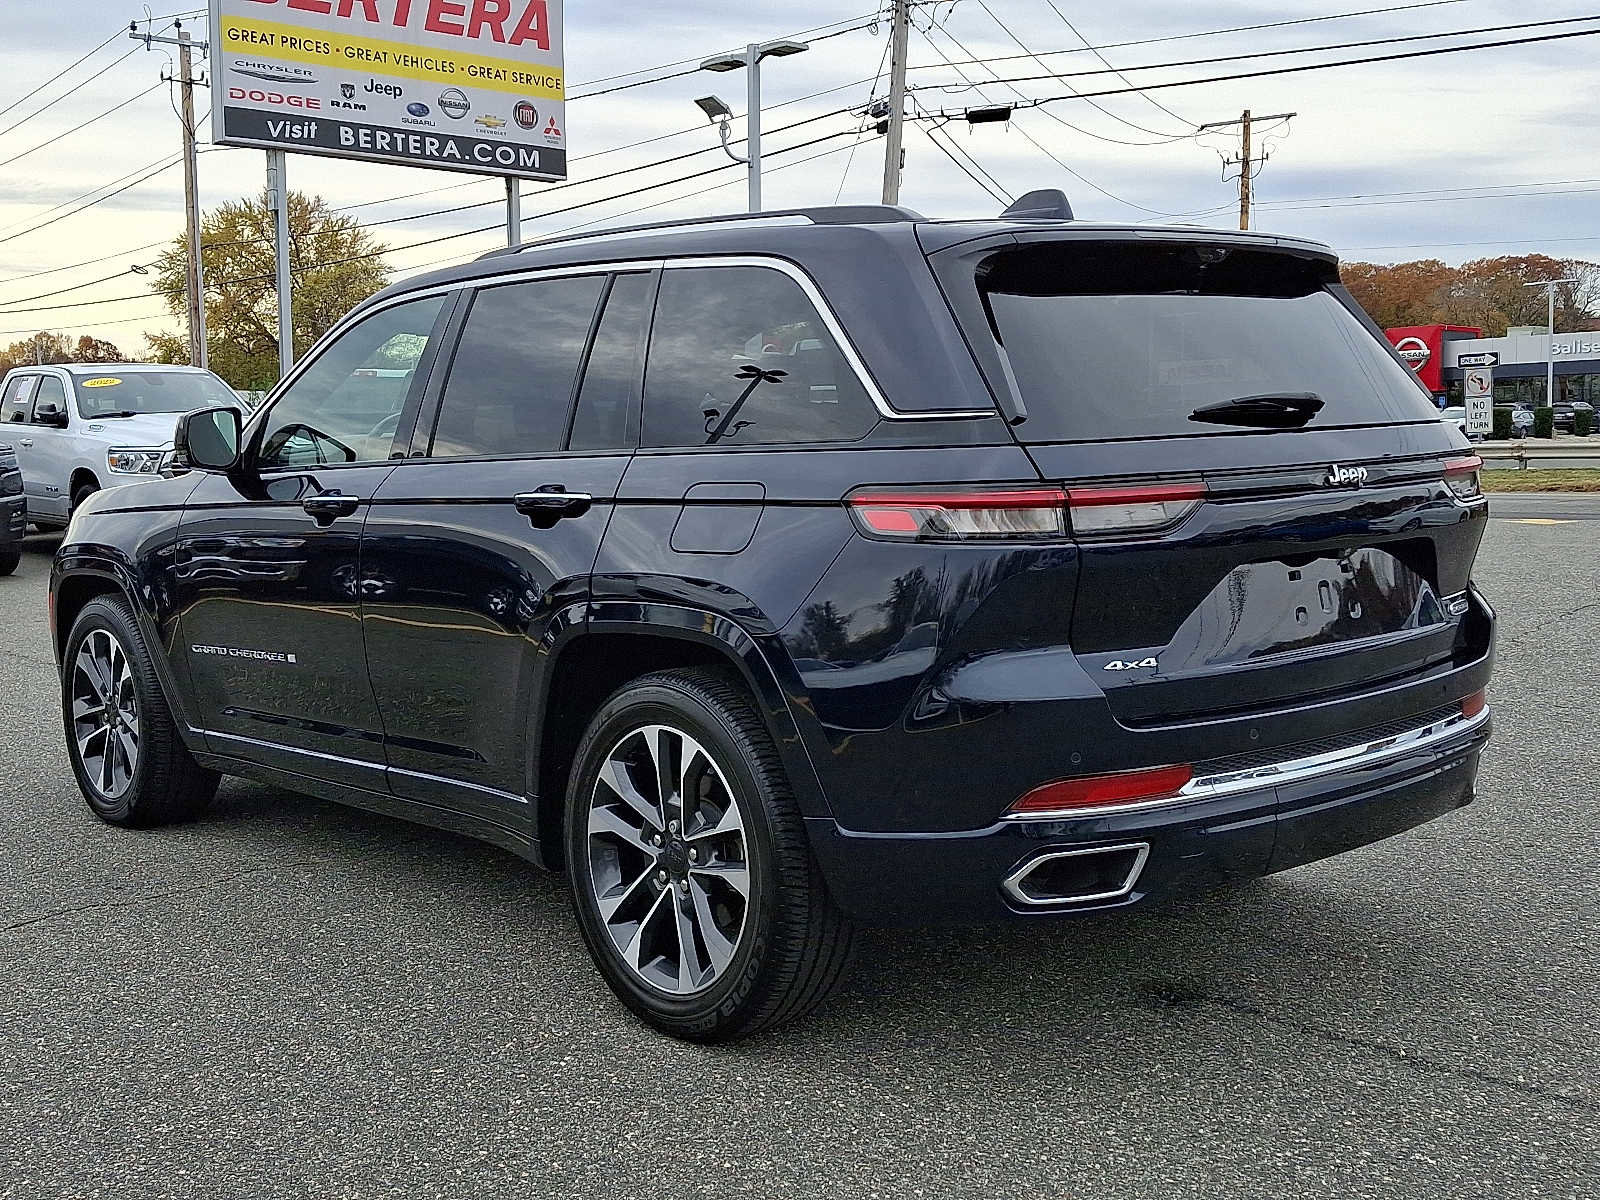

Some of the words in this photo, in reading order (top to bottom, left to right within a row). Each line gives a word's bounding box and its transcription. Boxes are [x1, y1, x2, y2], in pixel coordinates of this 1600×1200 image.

[228, 28, 275, 46] GREAT
[281, 36, 330, 55] PRICES
[344, 46, 389, 64] GREAT
[393, 54, 455, 74] VEHICLES
[468, 65, 507, 81] GREAT
[512, 71, 561, 90] SERVICE
[234, 60, 313, 77] CHRYSLER
[364, 78, 402, 99] Jeep
[229, 87, 321, 110] DODGE
[330, 100, 367, 111] RAM
[440, 100, 468, 110] NISSAN
[401, 117, 436, 127] SUBARU
[519, 108, 534, 123] FIAT
[267, 120, 318, 139] Visit
[339, 126, 540, 168] BERTERA.COM
[1401, 351, 1425, 359] SSAN
[1472, 401, 1485, 409] NO
[1470, 411, 1488, 420] LEFT
[1469, 421, 1489, 430] TURN
[1328, 464, 1368, 488] Jeep
[191, 644, 228, 656] GRAND
[229, 648, 286, 662] CHEROKEE
[1103, 657, 1158, 671] 4x4
